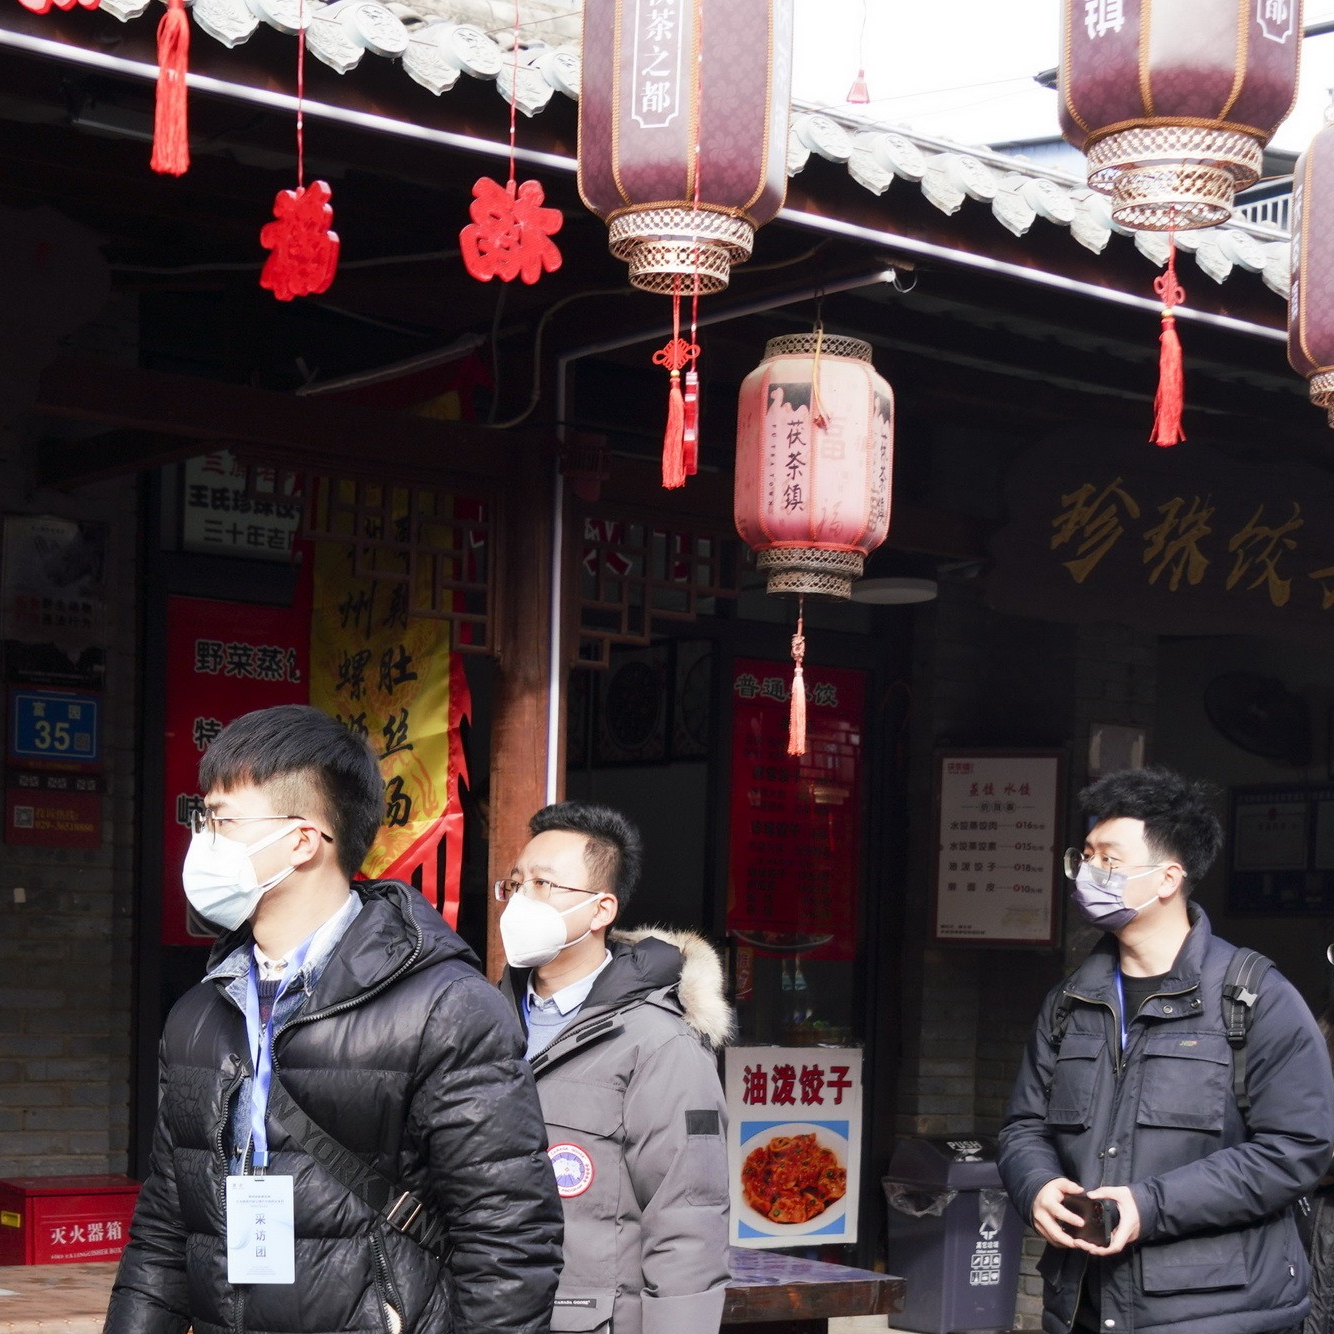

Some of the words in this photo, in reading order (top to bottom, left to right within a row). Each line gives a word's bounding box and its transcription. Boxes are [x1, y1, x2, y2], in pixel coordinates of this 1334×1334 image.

[641, 0, 675, 113] 茶之都
[203, 519, 295, 550] 三十年老
[734, 674, 839, 708] 普通饺
[34, 720, 70, 750] 35
[742, 1064, 852, 1106] 油泼饺子
[947, 1140, 983, 1151] PUSH
[49, 1221, 123, 1245] 灭火器箱
[255, 1213, 267, 1258] 采访团
